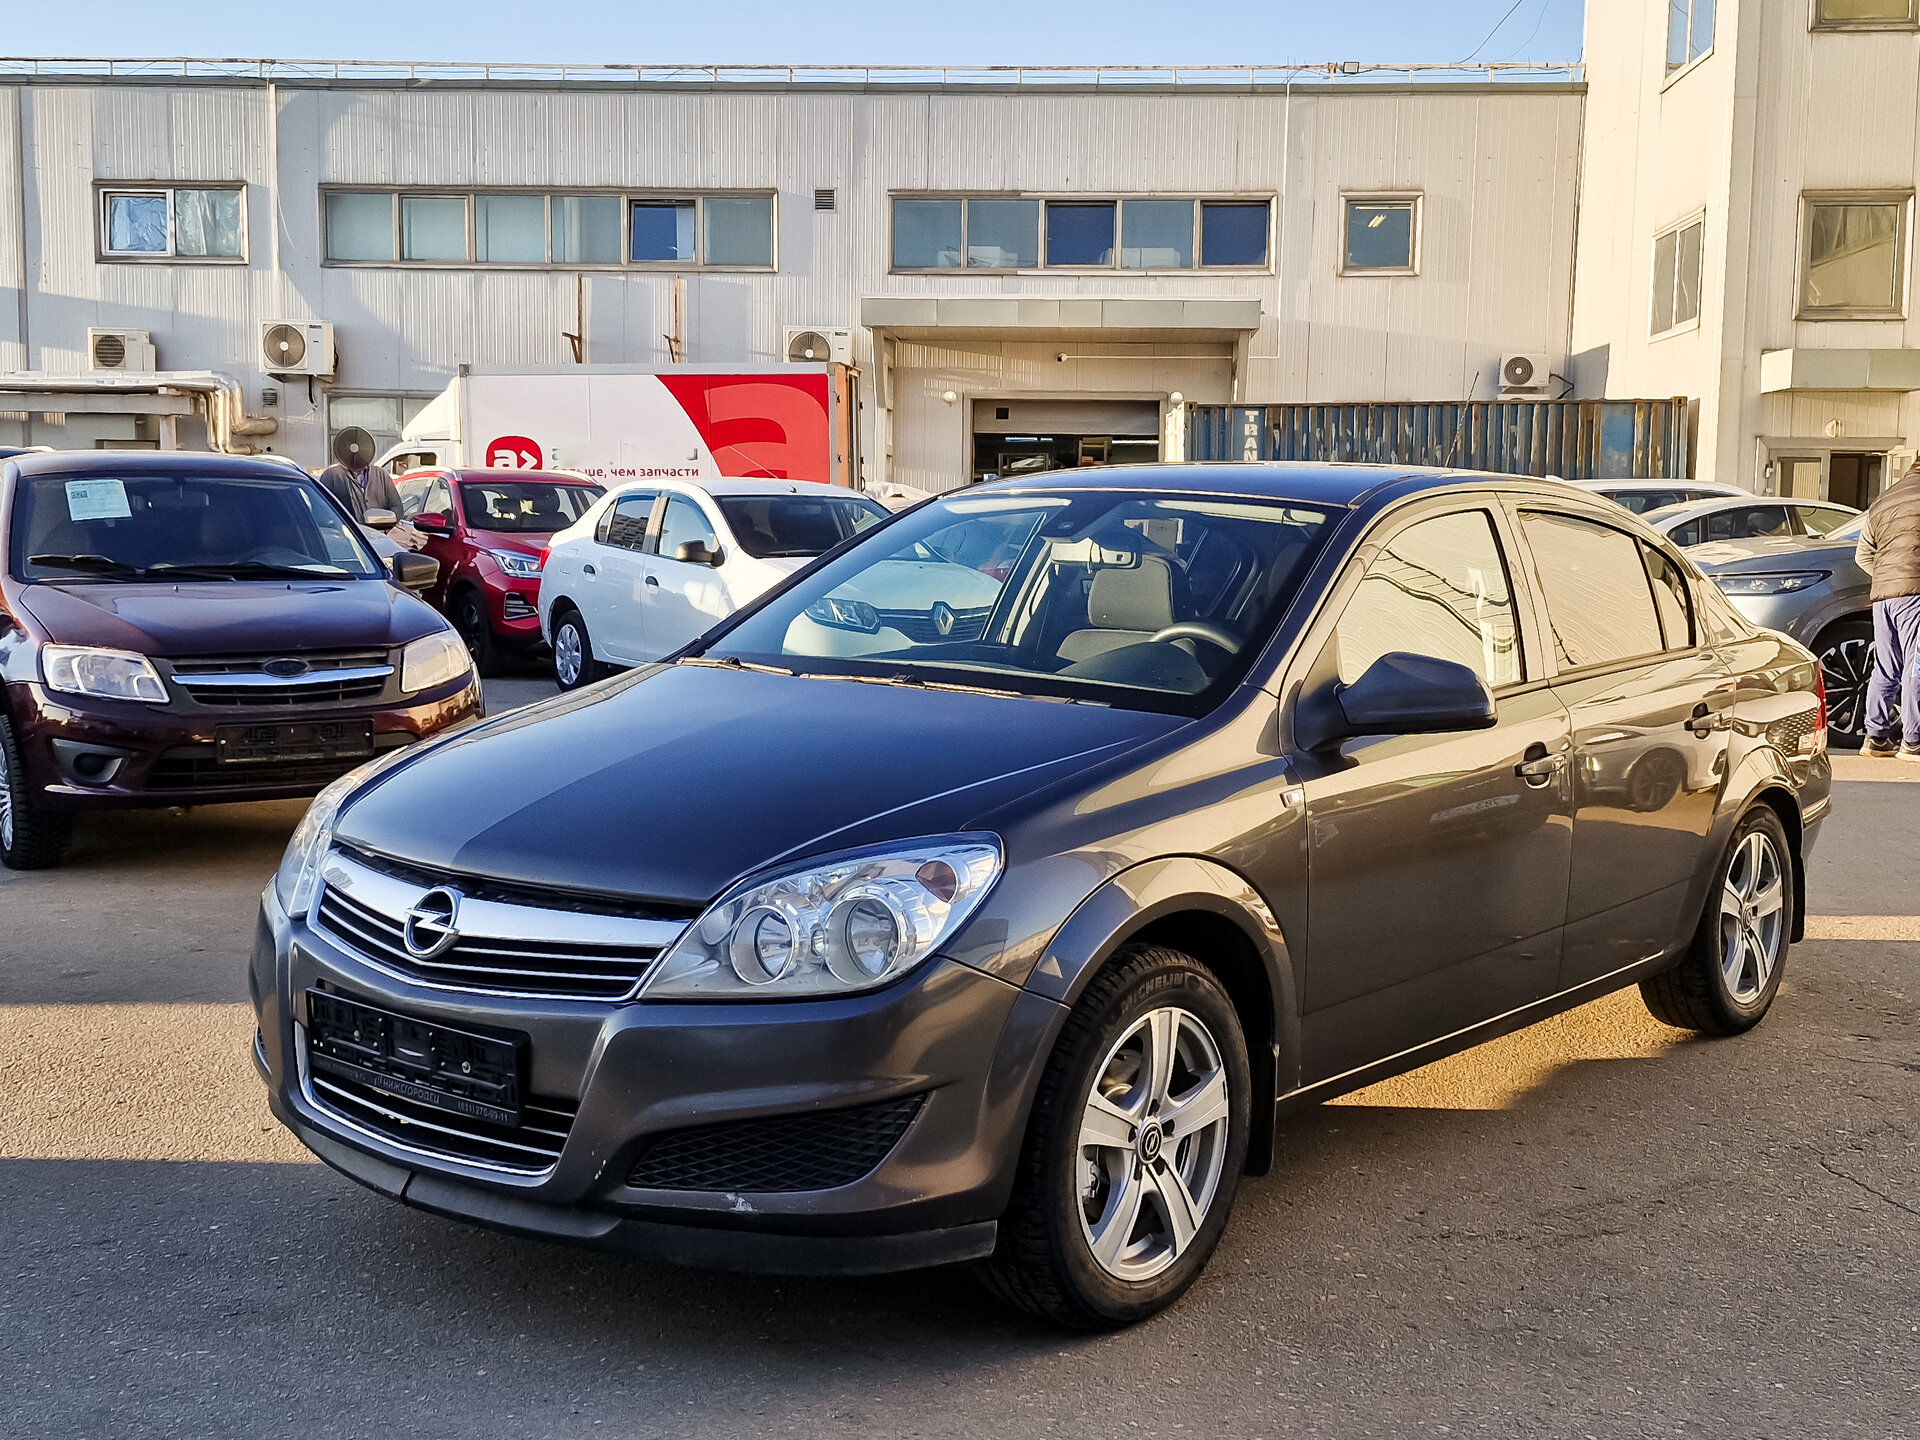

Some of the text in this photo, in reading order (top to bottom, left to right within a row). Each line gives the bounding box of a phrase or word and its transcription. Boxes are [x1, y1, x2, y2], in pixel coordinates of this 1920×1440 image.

[611, 467, 635, 477] чем
[640, 467, 699, 477] запчасти
[382, 1079, 440, 1105] НИЖЕГОРОДЕЦ
